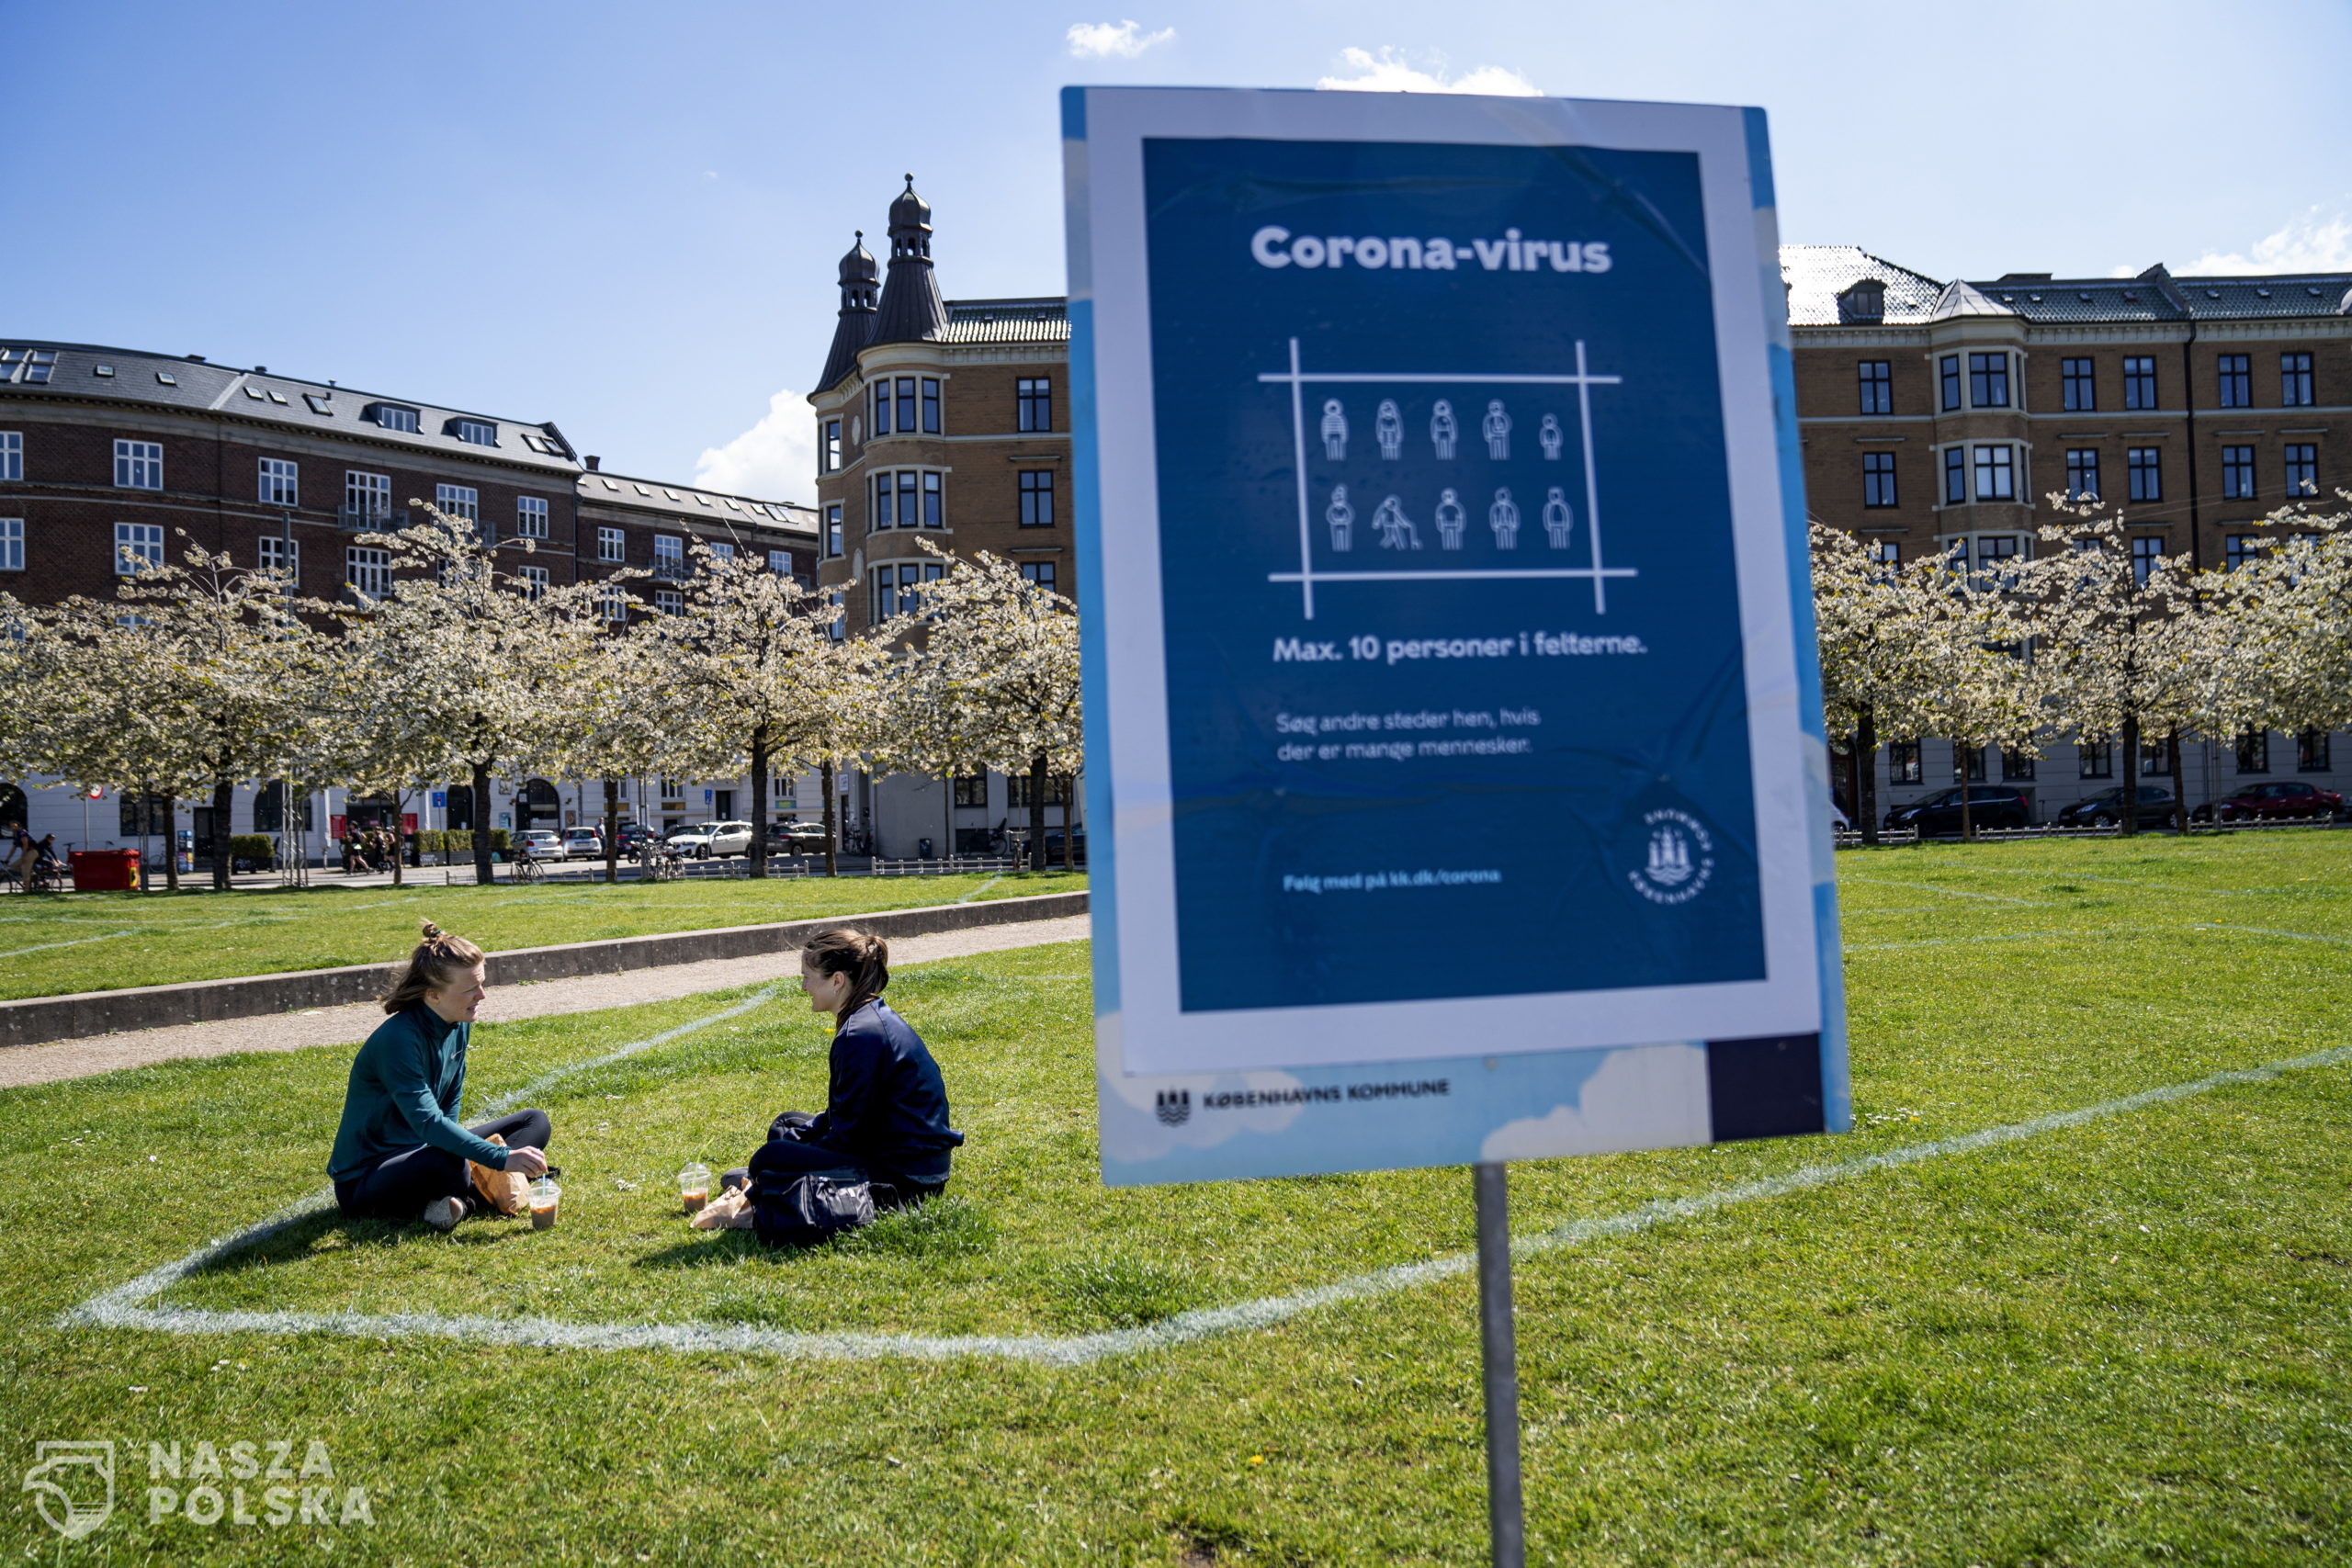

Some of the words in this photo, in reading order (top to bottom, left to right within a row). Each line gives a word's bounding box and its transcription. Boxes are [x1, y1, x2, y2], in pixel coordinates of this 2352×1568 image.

[1250, 225, 1613, 274] Corona-virus
[1273, 636, 1344, 662] Max.
[1348, 635, 1381, 660] 10
[1386, 637, 1515, 665] personer
[1519, 630, 1530, 656] i
[1533, 630, 1648, 656] felterne.
[1276, 712, 1318, 736] Søg
[1319, 711, 1380, 732] andre
[1384, 709, 1451, 730] steder
[1453, 708, 1498, 729] hen,
[1499, 705, 1542, 727] hvis
[1277, 740, 1315, 761] der
[1317, 744, 1342, 761] er
[1345, 739, 1416, 761] mange
[1418, 735, 1533, 757] mennesker.
[1283, 874, 1322, 895] Følg
[1323, 873, 1363, 889] med
[1365, 869, 1388, 892] på
[1389, 868, 1503, 887] kk.dk/corona
[1203, 1085, 1341, 1111] KØBENHAVNS
[1347, 1077, 1451, 1101] KOMMUNE
